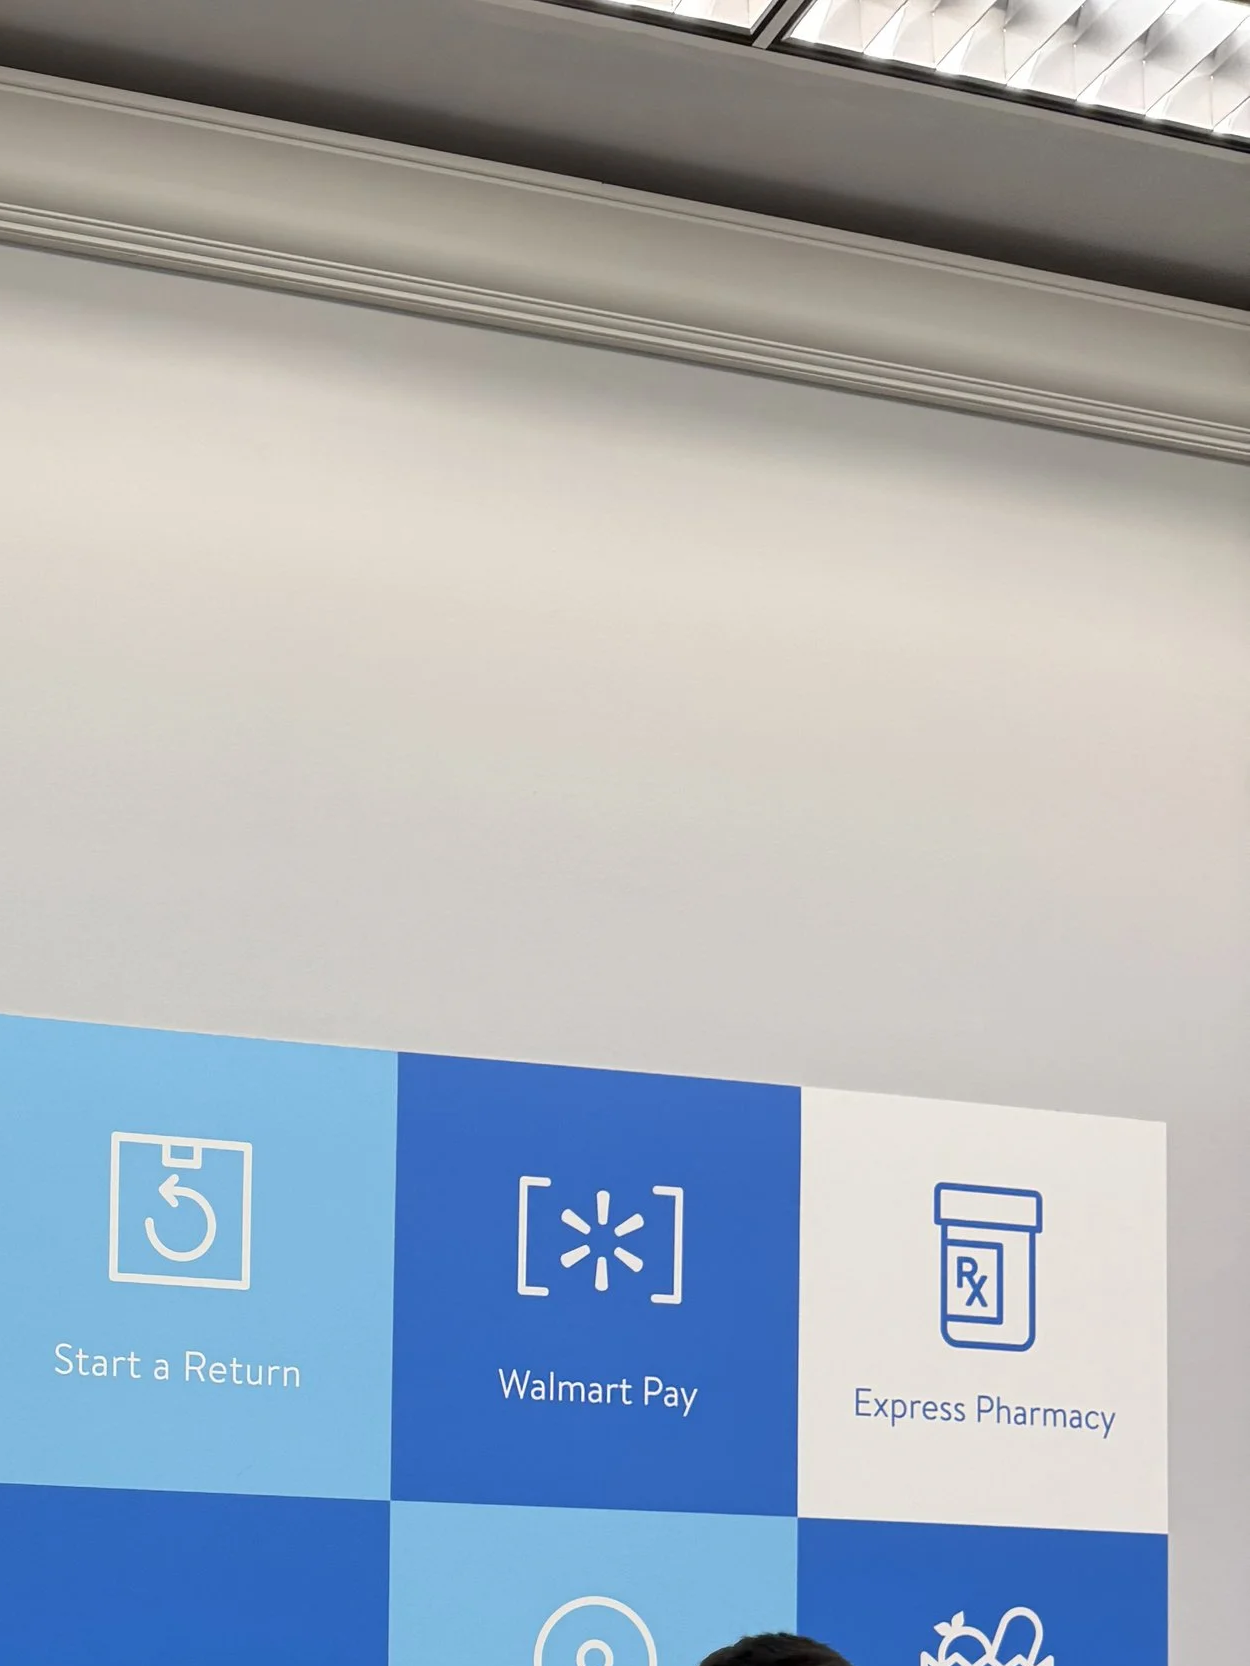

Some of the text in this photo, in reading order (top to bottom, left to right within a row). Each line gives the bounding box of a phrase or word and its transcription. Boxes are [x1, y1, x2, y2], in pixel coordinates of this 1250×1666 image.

[54, 1342, 300, 1388] Start a Return
[498, 1368, 699, 1418] Walmart Pay
[855, 1387, 1116, 1440] Express Pharmacy
